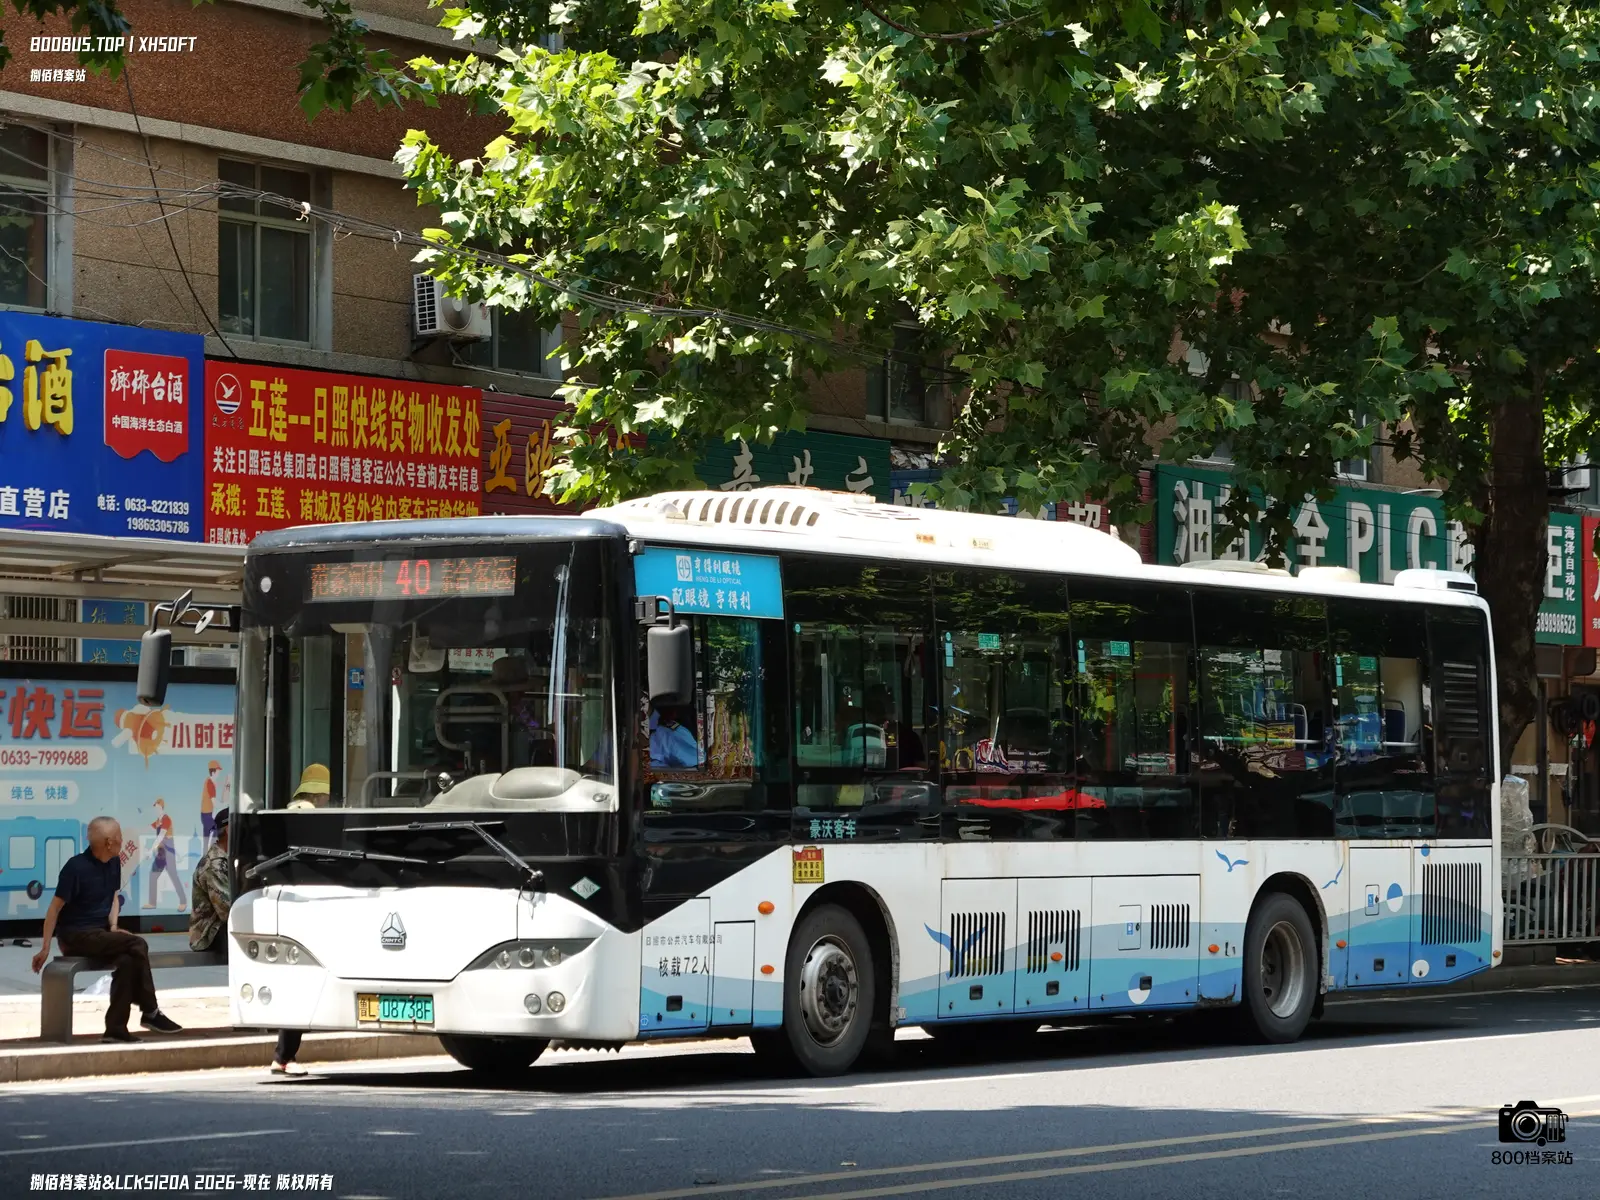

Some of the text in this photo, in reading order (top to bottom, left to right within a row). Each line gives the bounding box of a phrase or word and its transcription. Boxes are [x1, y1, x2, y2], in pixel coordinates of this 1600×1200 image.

[112, 414, 183, 434] 中国海洋生态白酒
[212, 445, 479, 493] 关注日照运总集团或日照博通客运公众号查询发车信息
[127, 517, 189, 534] 19863305786
[396, 559, 431, 595] 40
[671, 587, 750, 611] 配眼镜 亨得利
[0, 686, 105, 739] 快运
[1, 750, 89, 766] 0633-7999688
[11, 785, 69, 801] 绿色 快捷
[809, 819, 857, 839] 豪沃客车
[659, 956, 710, 977] 核载72人
